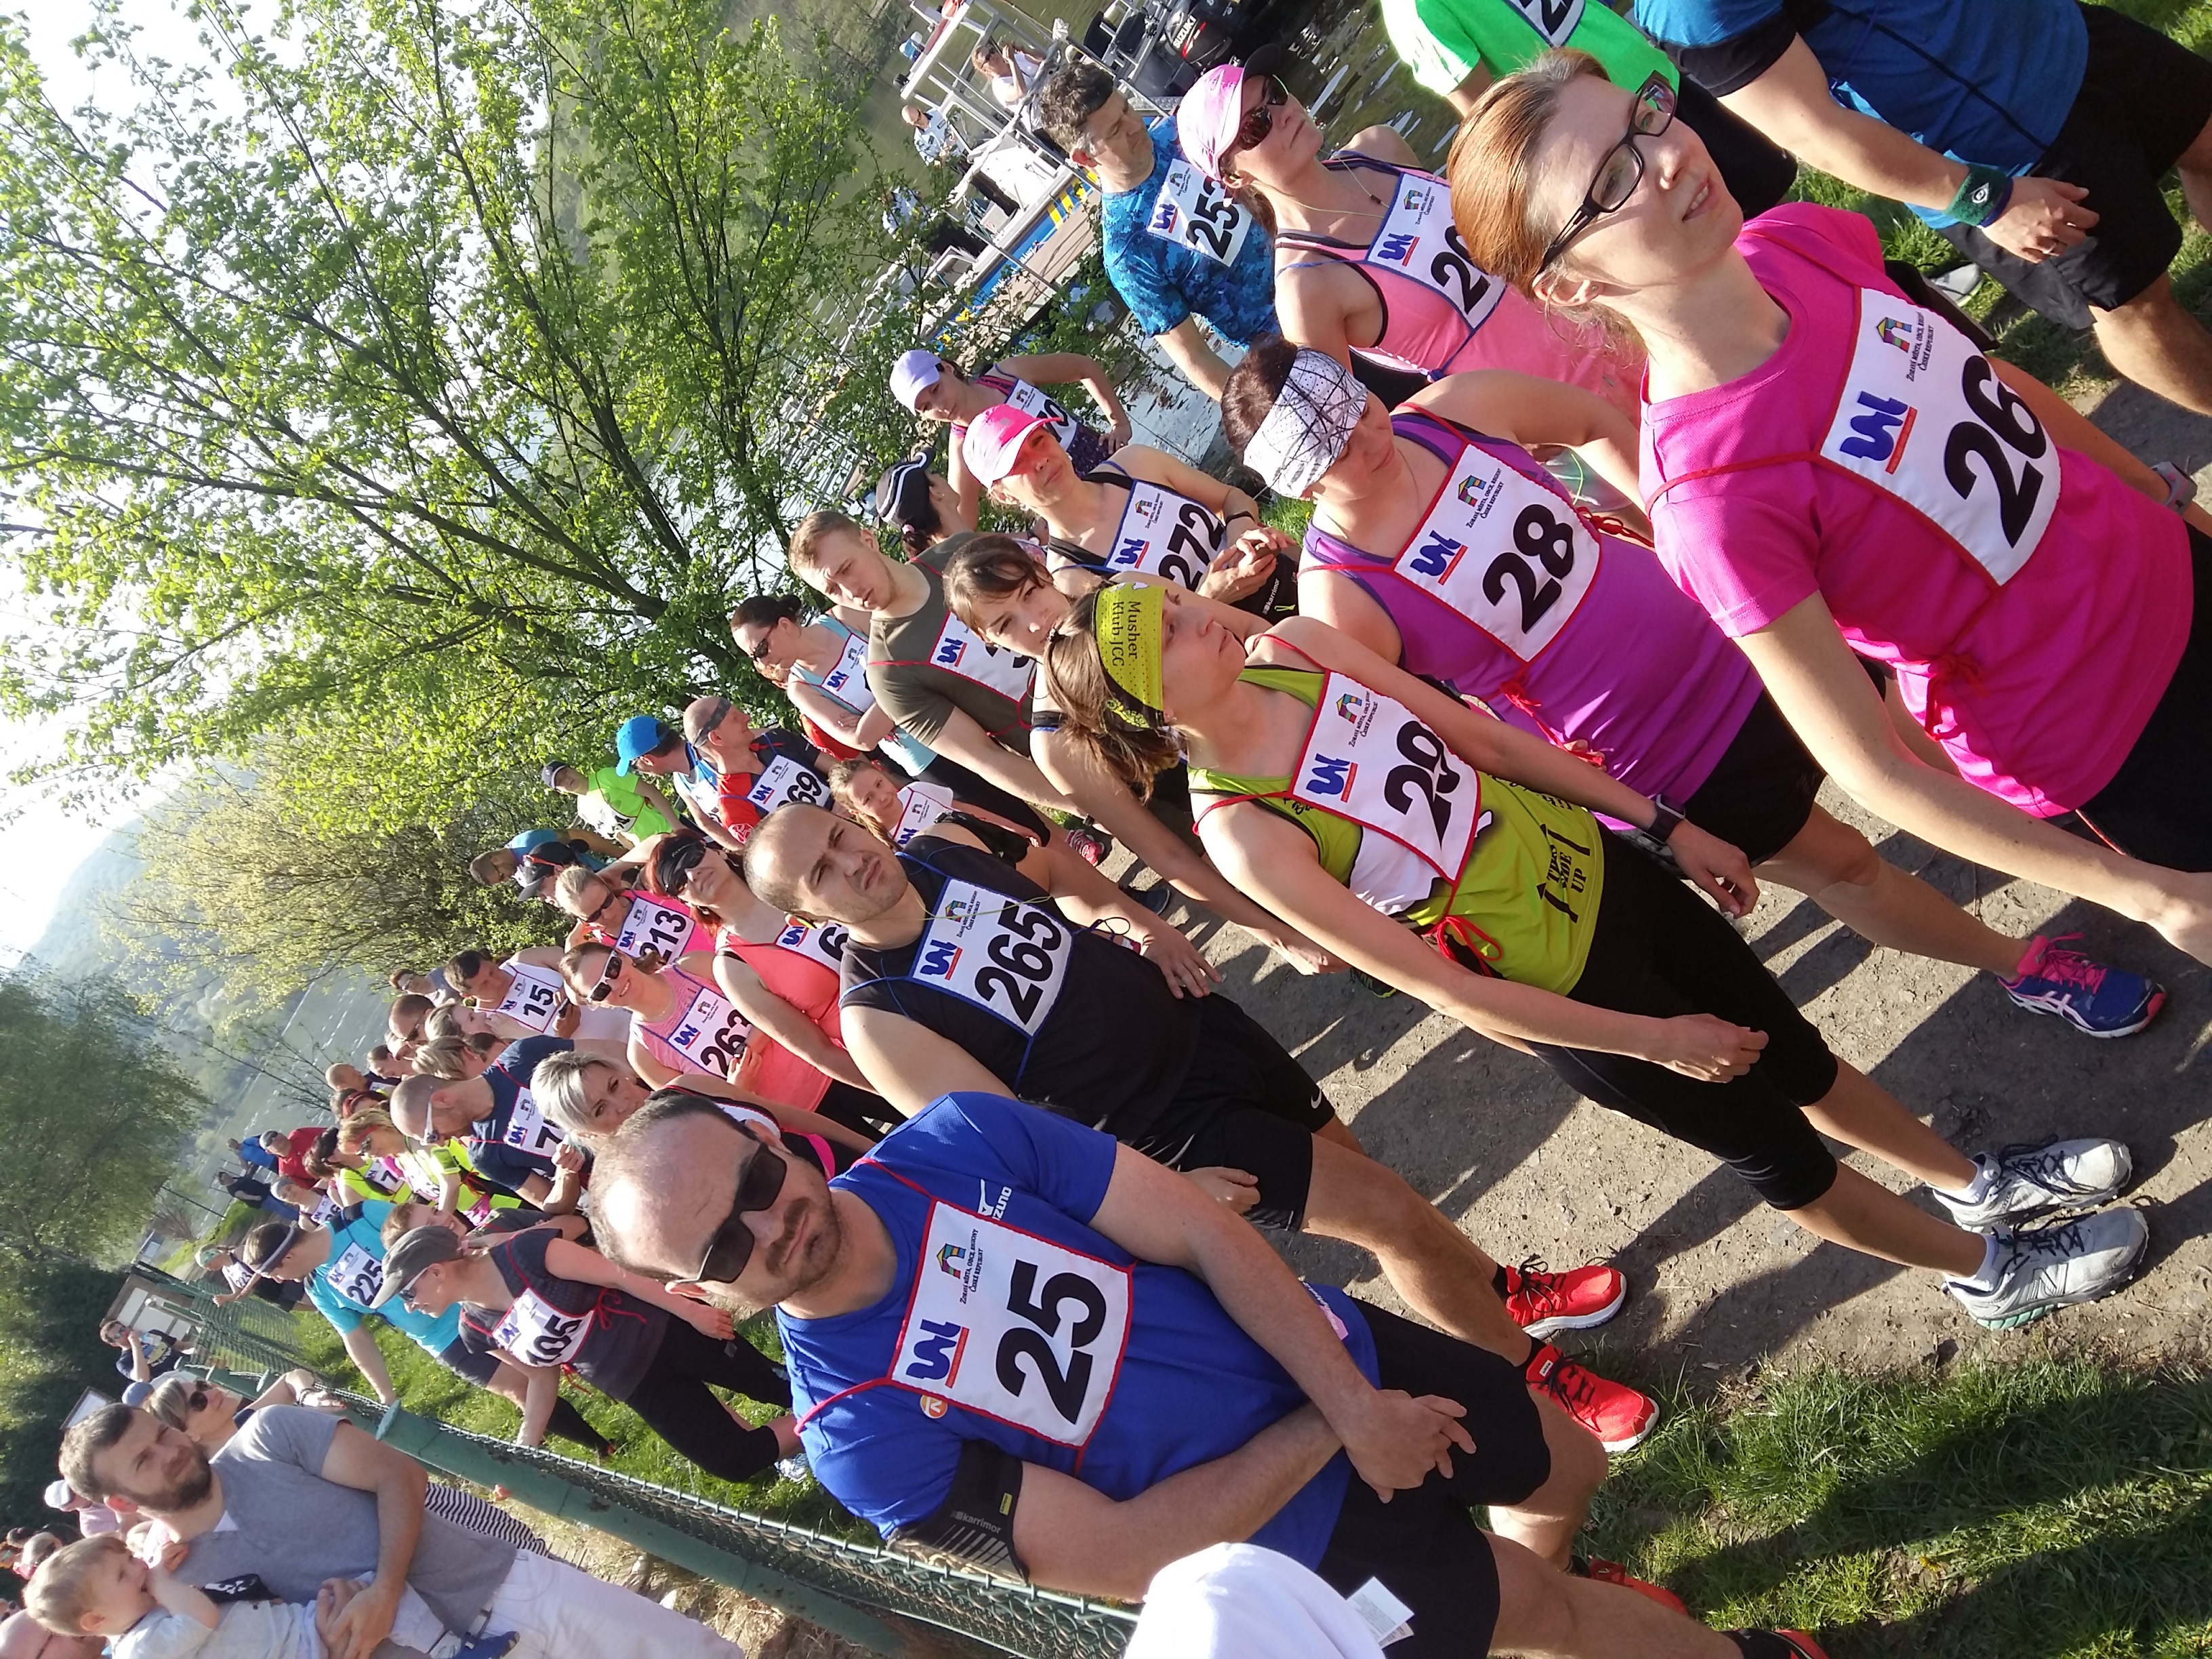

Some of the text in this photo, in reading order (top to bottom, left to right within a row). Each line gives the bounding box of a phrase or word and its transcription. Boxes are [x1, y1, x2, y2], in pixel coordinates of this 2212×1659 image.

[1172, 15, 1197, 49] SUZUKI
[1943, 354, 2048, 549] 26
[1158, 503, 1221, 590] 272
[1482, 504, 1575, 635] 28
[1266, 578, 1279, 606] karrimor
[1109, 601, 1124, 666] Klub JCC
[1127, 600, 1141, 659] Musher
[777, 771, 822, 806] 69
[1383, 720, 1460, 850] 29
[1571, 867, 1586, 893] UP
[640, 910, 687, 965] 213
[974, 900, 1063, 1025] 265
[523, 985, 554, 1017] 15
[346, 1259, 384, 1306] 225
[996, 1258, 1107, 1425] 25
[962, 1513, 1002, 1534] karrimor
